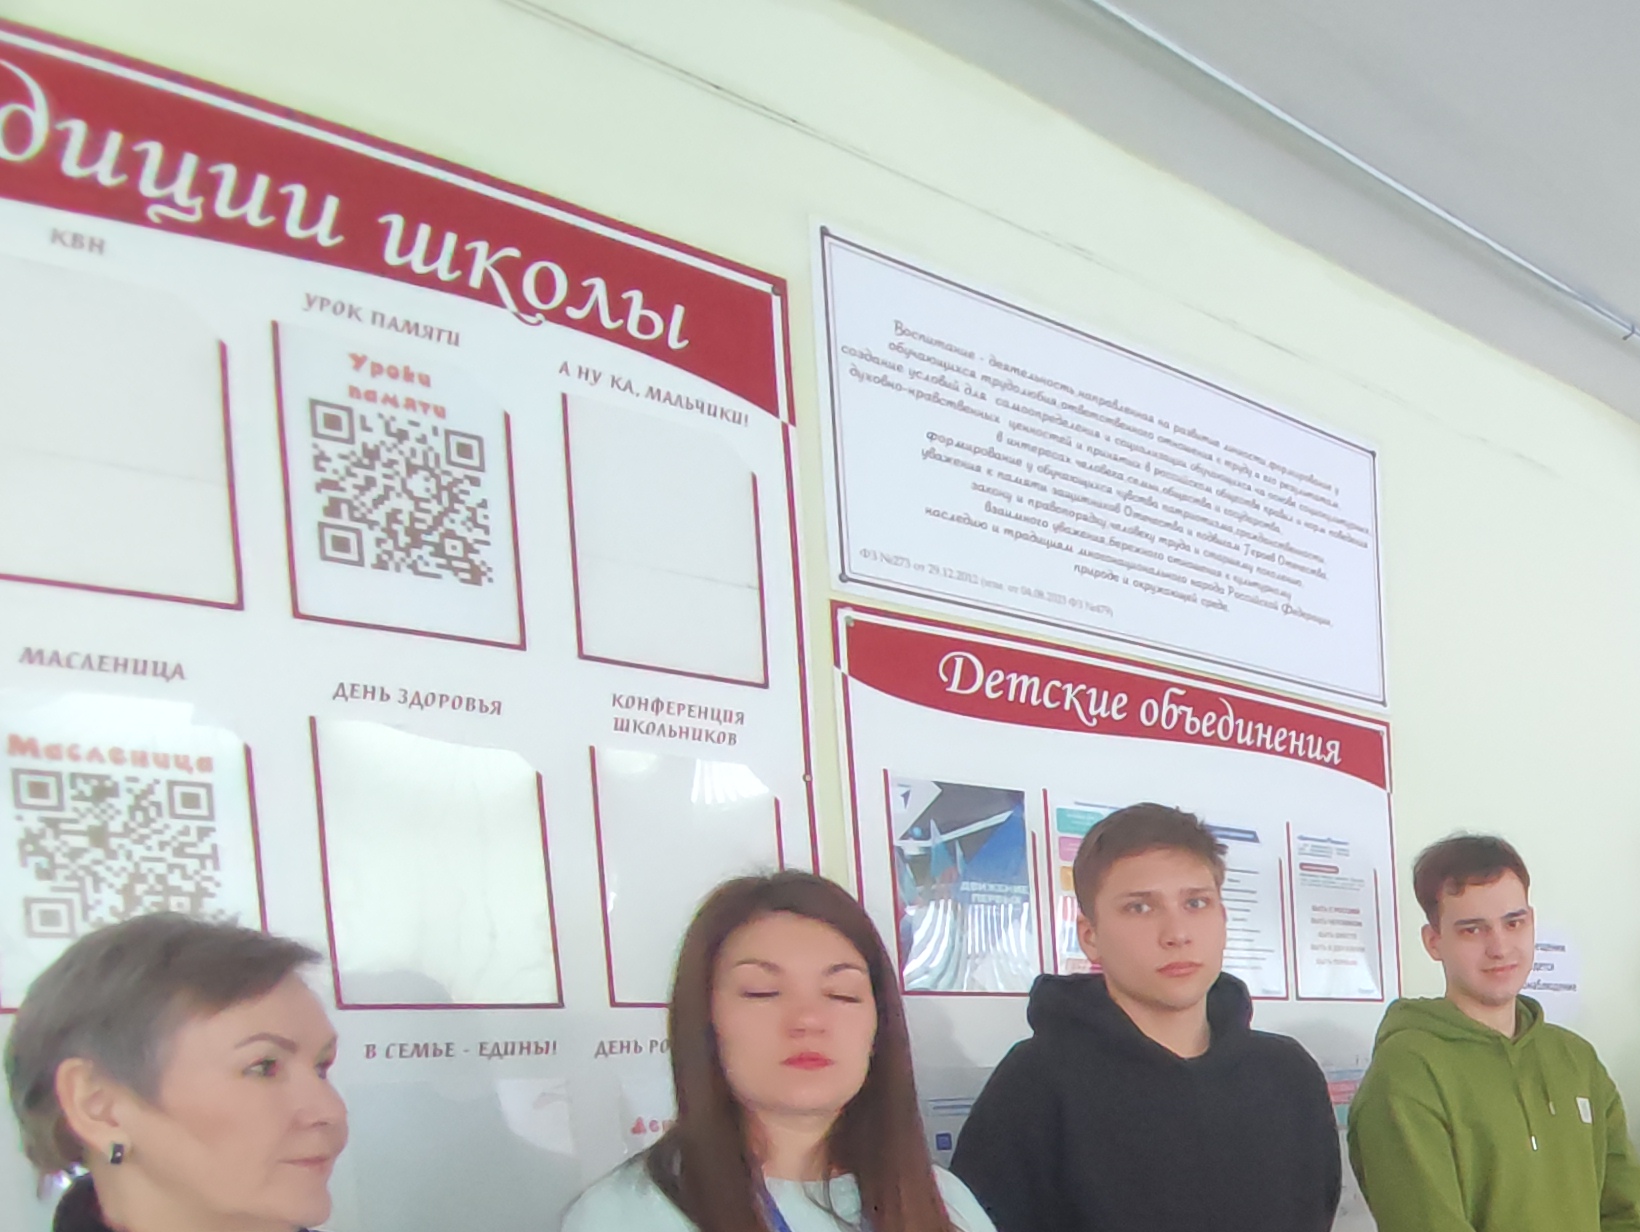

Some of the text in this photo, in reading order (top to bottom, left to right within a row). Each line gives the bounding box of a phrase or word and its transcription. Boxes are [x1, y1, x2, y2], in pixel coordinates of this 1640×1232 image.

[50, 227, 106, 257] КВН
[378, 212, 691, 350] школы
[303, 292, 462, 348] УРОК ПАМЯТИ
[893, 319, 975, 360] Воспитание
[348, 352, 431, 388] Уроки
[840, 345, 904, 373] создание
[908, 368, 960, 393] условий
[888, 341, 977, 379] обучающихся
[559, 360, 571, 378] А
[577, 365, 604, 388] НУ
[645, 384, 750, 428] МАЛЬЧИКИ!
[849, 363, 1001, 424] духовно-нравственных
[921, 446, 982, 473] уважения
[925, 431, 1023, 467] формирование
[924, 508, 988, 530] наследию
[984, 500, 1049, 528] взаимного
[19, 646, 187, 683] МАСЛЕНИЦА
[333, 681, 504, 717] ДЕНЬ ЗДОРОВЬЯ
[611, 692, 747, 727] КОНФЕРЕНЦИЯ
[938, 650, 1343, 767] Детские объединения
[613, 716, 739, 747] ШКОЛЬНИКОВ
[7, 733, 215, 776] Масленица
[364, 1042, 377, 1060] В
[384, 1041, 454, 1060] СЕМЬЕ
[478, 1040, 558, 1063] ЕДИНЫ!
[594, 1040, 643, 1059] ДЕНЬ
